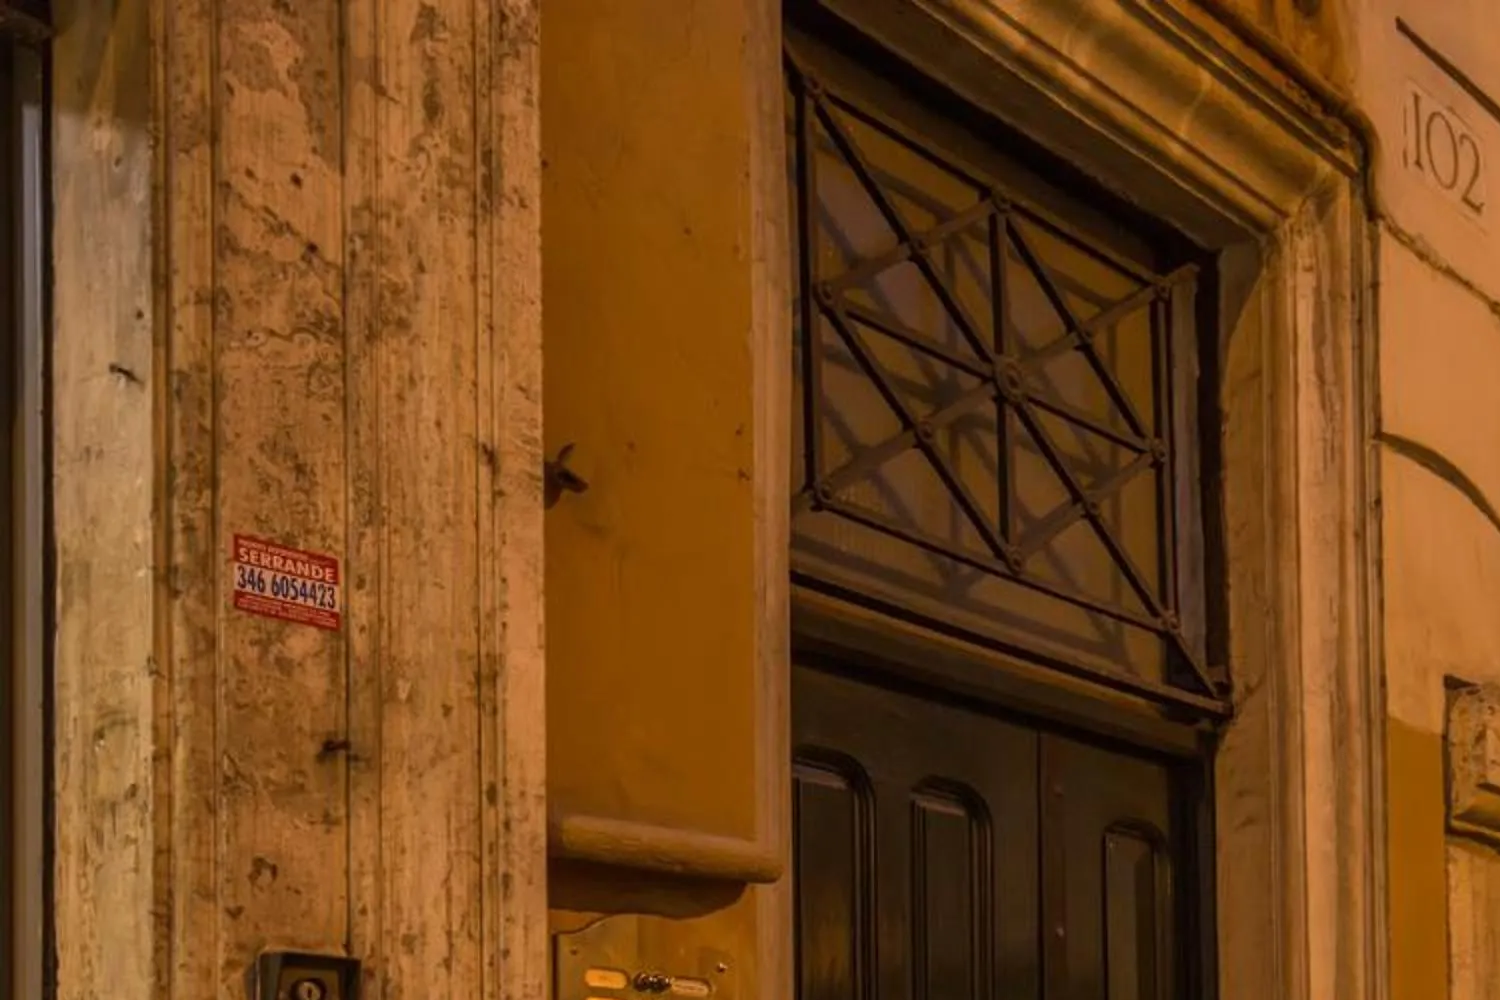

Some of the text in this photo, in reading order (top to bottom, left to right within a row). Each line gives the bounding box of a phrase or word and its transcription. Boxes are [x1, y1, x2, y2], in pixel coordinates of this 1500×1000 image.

[1411, 91, 1486, 216] 102
[237, 565, 336, 609] 346 6054423
[238, 547, 336, 583] SERRANDE
